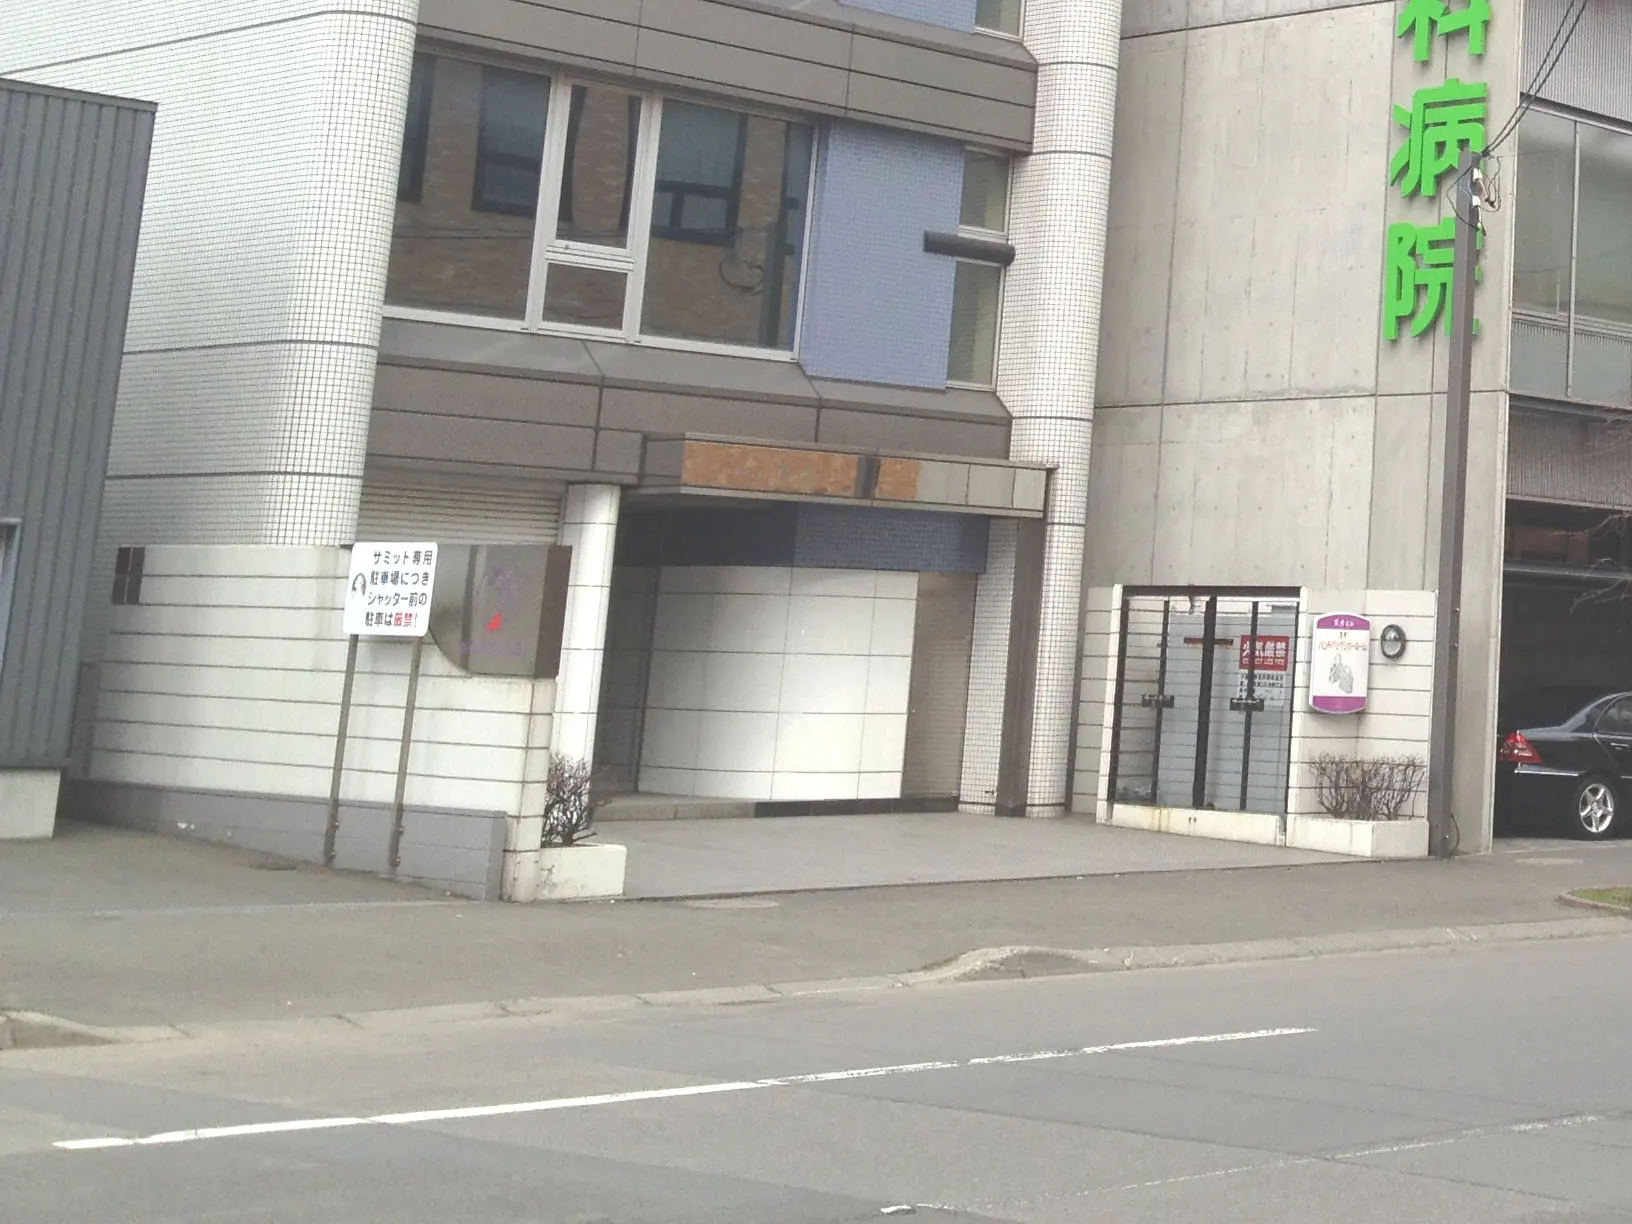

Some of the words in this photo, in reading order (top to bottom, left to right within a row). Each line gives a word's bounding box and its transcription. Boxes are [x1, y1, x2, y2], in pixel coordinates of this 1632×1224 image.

[374, 550, 433, 565] サミット専用
[370, 570, 429, 586] 駐車場につき
[368, 592, 427, 607] シャッター前の
